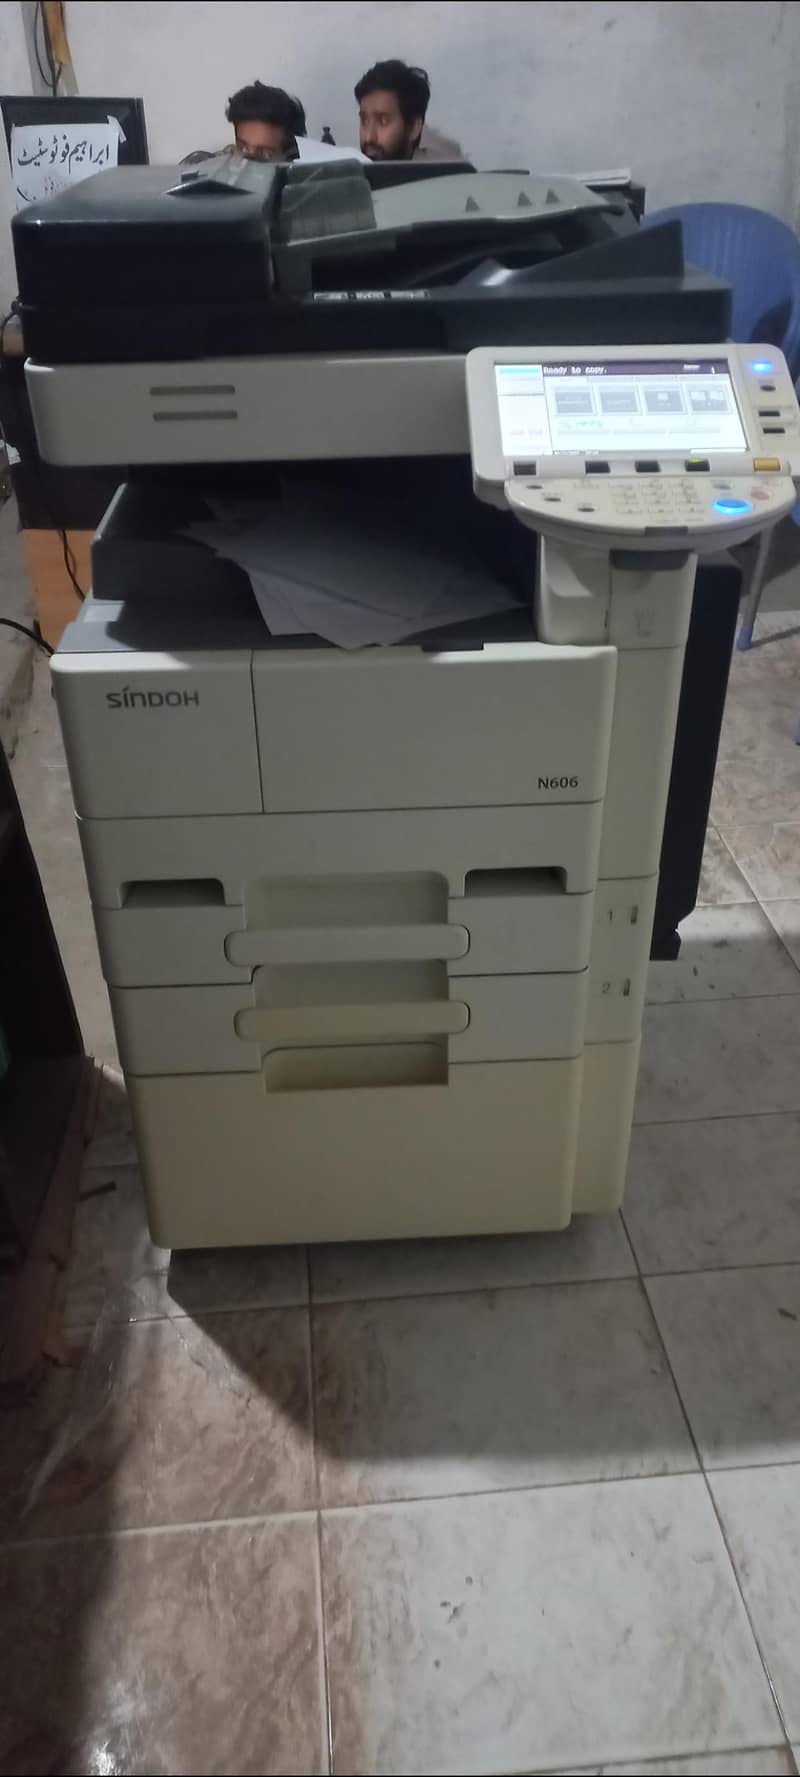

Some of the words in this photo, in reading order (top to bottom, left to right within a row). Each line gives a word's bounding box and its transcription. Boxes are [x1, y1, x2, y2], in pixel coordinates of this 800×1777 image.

[543, 365, 568, 375] Ready
[571, 366, 582, 374] to
[537, 775, 579, 790] N606
[602, 981, 611, 994] 2
